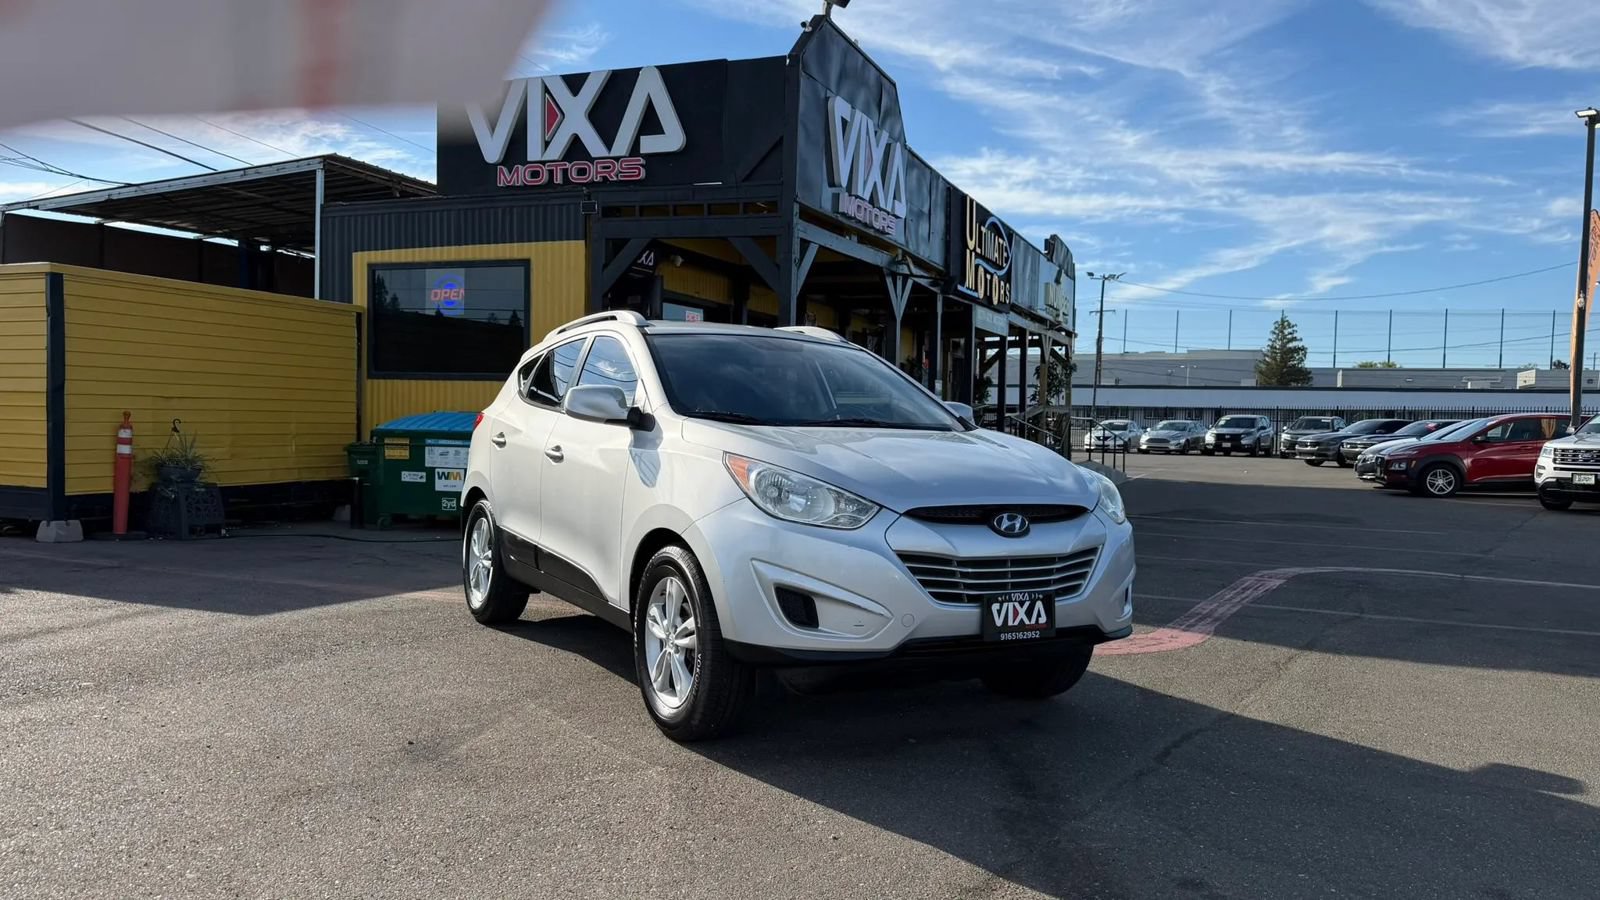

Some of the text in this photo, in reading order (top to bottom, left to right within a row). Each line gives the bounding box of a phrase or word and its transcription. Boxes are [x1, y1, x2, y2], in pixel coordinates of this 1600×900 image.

[464, 65, 686, 164] VIXA
[828, 95, 906, 219] VIXA
[497, 157, 645, 187] MOTORS
[839, 192, 897, 235] MOTORS
[437, 471, 462, 480] WM
[1011, 592, 1030, 601] VIXA
[991, 600, 1047, 627] VIXA
[1000, 630, 1040, 640] 9165162952
